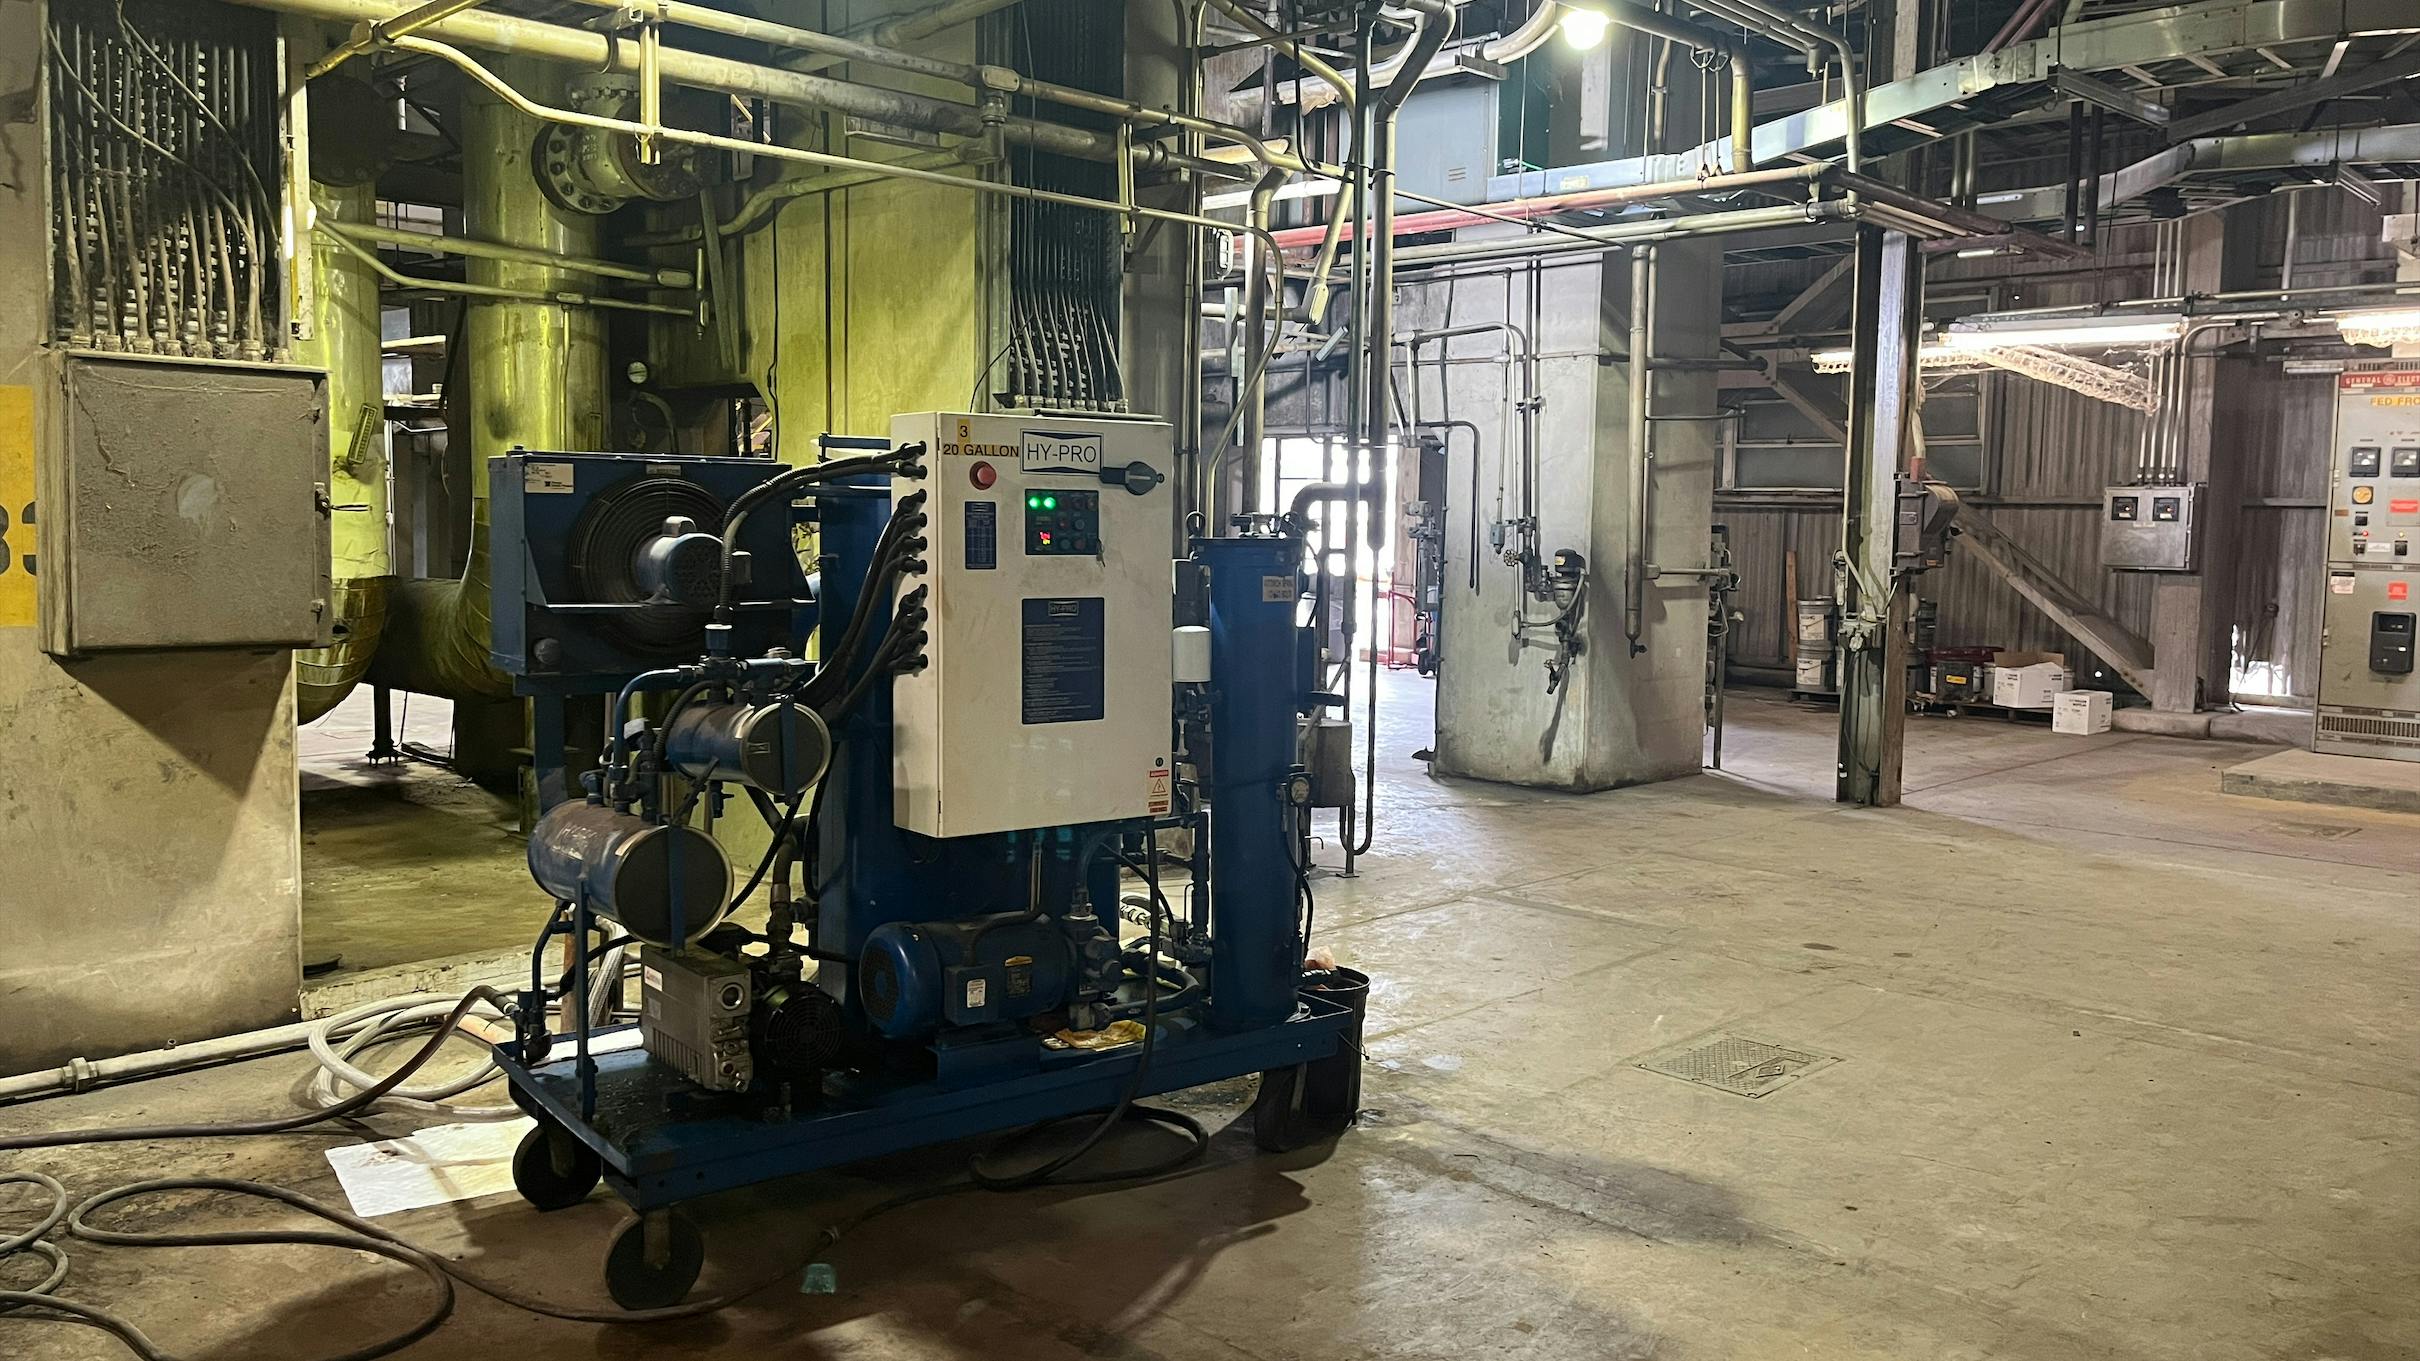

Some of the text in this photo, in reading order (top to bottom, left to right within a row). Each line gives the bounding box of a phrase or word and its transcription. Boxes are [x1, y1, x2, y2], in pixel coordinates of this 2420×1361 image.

[2370, 397, 2393, 406] FED
[959, 425, 968, 438] 3
[943, 444, 1019, 457] 20 GALLON
[1027, 443, 1097, 463] HY-PRO
